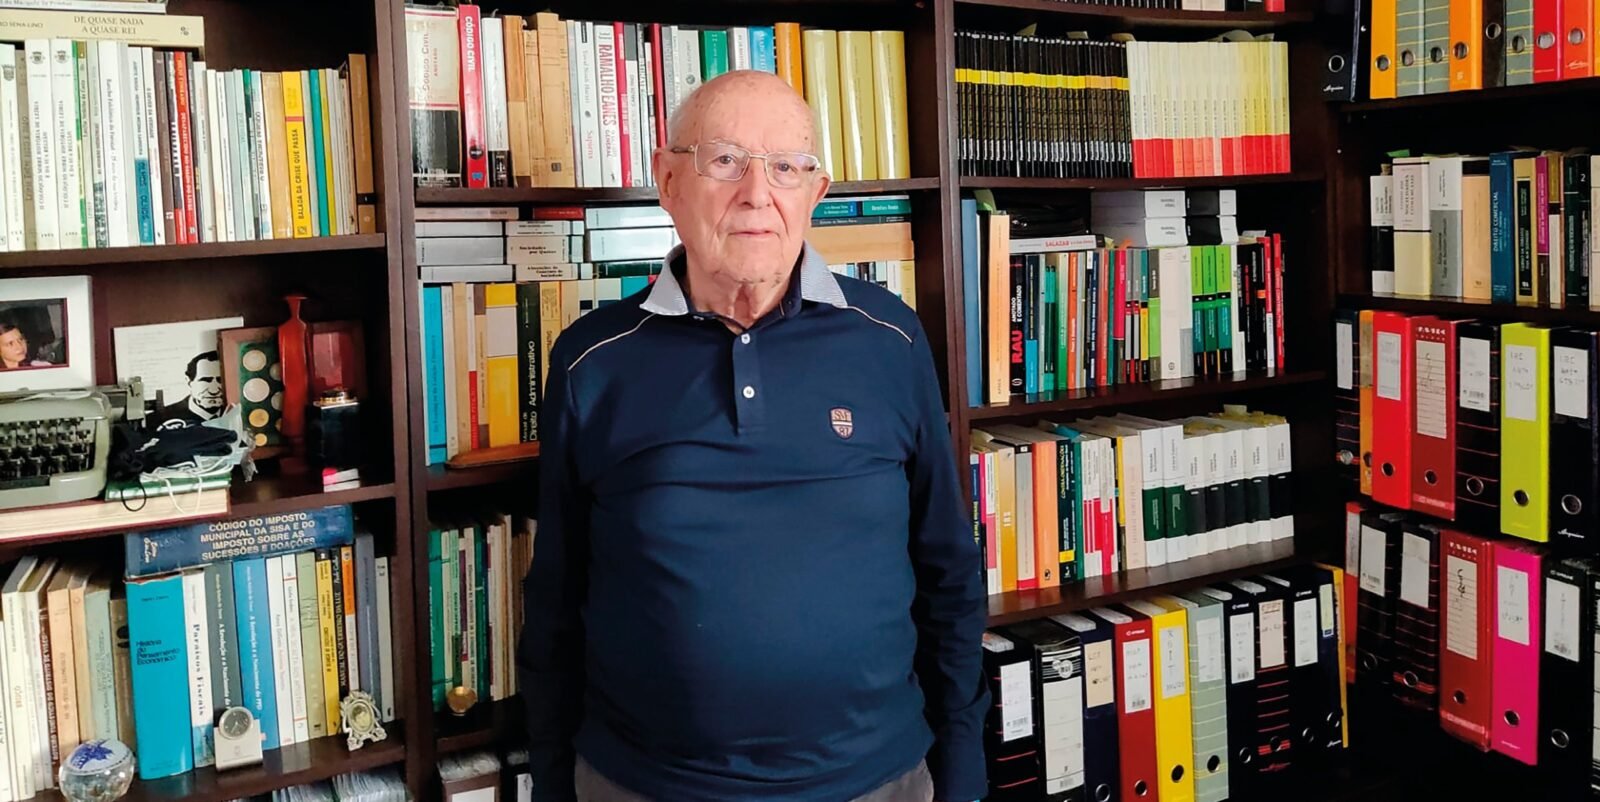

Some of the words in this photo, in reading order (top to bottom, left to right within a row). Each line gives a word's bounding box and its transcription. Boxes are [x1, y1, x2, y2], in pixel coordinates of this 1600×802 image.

[465, 16, 475, 48] CÓDIGO
[599, 44, 615, 93] RAMALHO
[602, 96, 616, 126] EANES
[1012, 330, 1023, 363] RAU
[528, 341, 537, 406] Administrativo
[529, 411, 538, 441] Direito
[201, 530, 251, 543] MUNICIPAL
[254, 527, 267, 535] DA
[270, 524, 291, 533] SISA
[302, 520, 314, 529] DO
[209, 520, 246, 532] CÓDIGO
[249, 519, 262, 527] DO
[266, 513, 306, 524] IMPOSTO
[202, 546, 259, 560] SUCESSÕES
[271, 537, 315, 550] DOAÇÕES
[213, 537, 255, 550] IMPOSTO
[257, 532, 289, 544] SOBRE
[292, 530, 304, 539] AS
